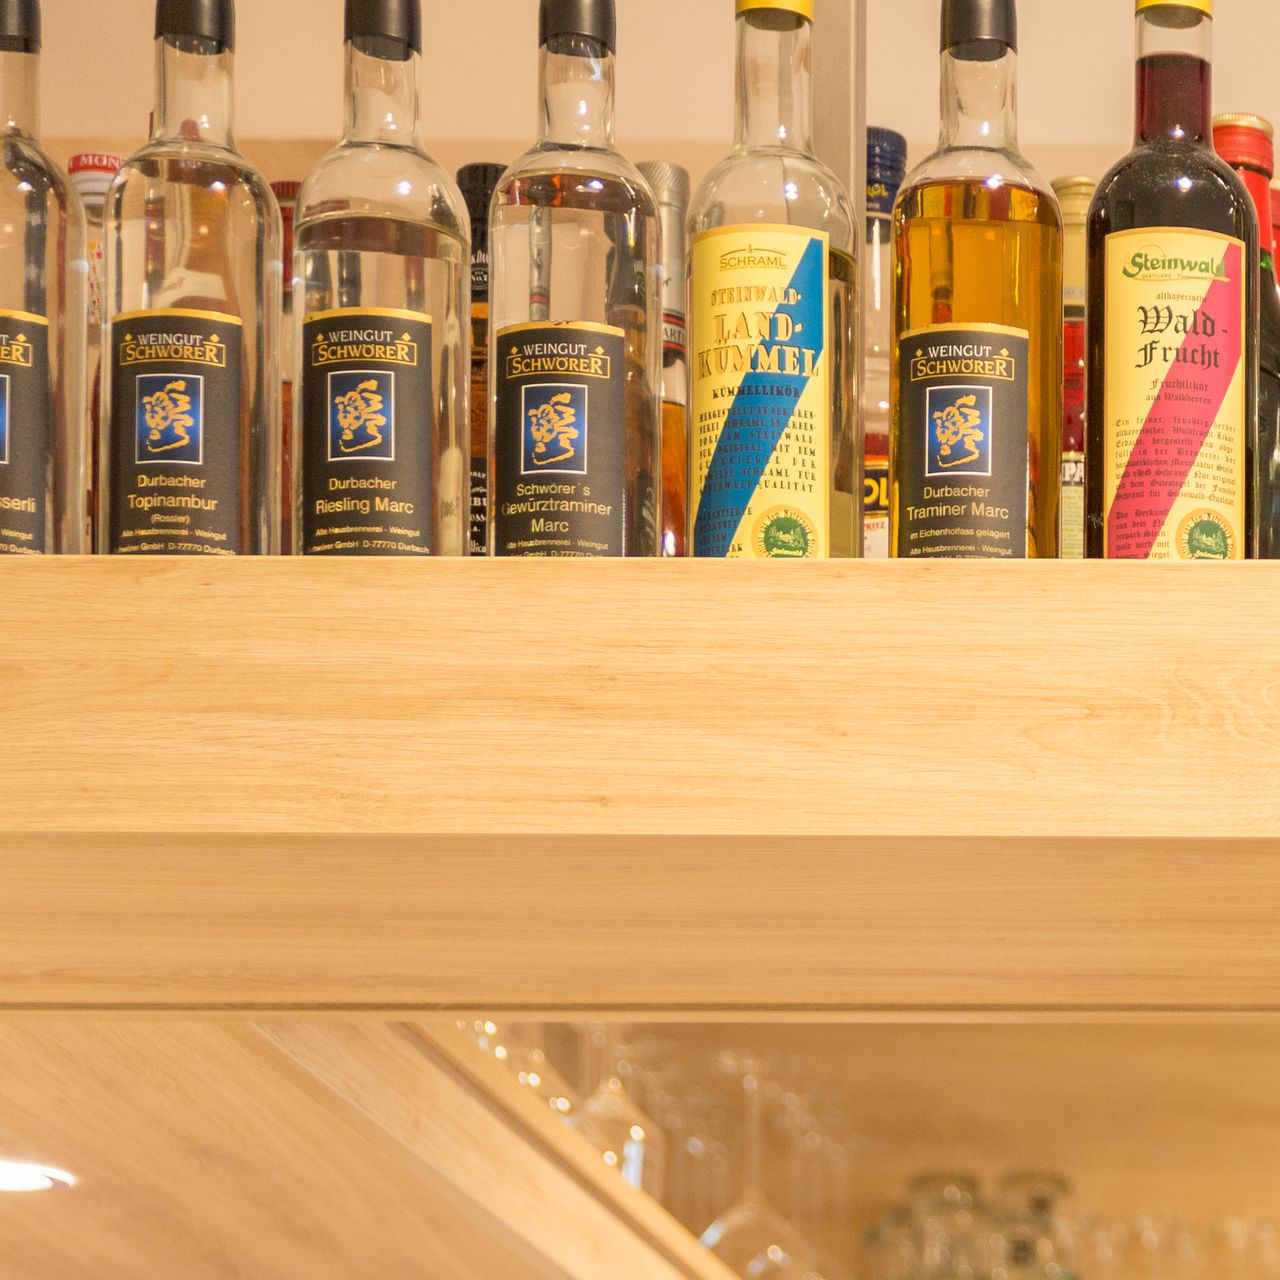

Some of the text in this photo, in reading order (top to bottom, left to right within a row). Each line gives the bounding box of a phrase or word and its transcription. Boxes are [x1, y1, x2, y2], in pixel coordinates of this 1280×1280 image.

[720, 256, 787, 269] SCHRAML
[714, 311, 803, 342] LAND-
[138, 333, 203, 346] WEINGUT
[329, 330, 393, 342] WEINGUT
[126, 343, 219, 362] SCHWÖRER
[318, 343, 410, 362] SCHWÖRER
[523, 343, 588, 355] WEINGUT
[928, 345, 992, 358] WEINGUT
[1135, 339, 1220, 370] Frucht
[512, 357, 603, 374] SCHWÖRER
[698, 339, 819, 380] KÜMMEL
[917, 358, 1008, 376] SCHWÖRER
[713, 384, 800, 398] KÜMMELLIKÖR
[138, 475, 206, 488] Durbacher
[329, 477, 397, 490] Durbacher
[924, 485, 990, 499] Durbacher
[128, 494, 218, 511] Topinambur
[316, 497, 414, 514] Riesling Marc
[501, 497, 612, 516] Gewürztraminer
[907, 502, 1009, 521] Traminer Marc
[390, 527, 420, 537] Weingut
[531, 519, 569, 533] Marc
[976, 528, 1010, 540] gelagert
[335, 541, 359, 549] GmbH
[363, 541, 396, 549] D-77770
[578, 539, 609, 550] Weingut
[982, 545, 1012, 556] Weingut
